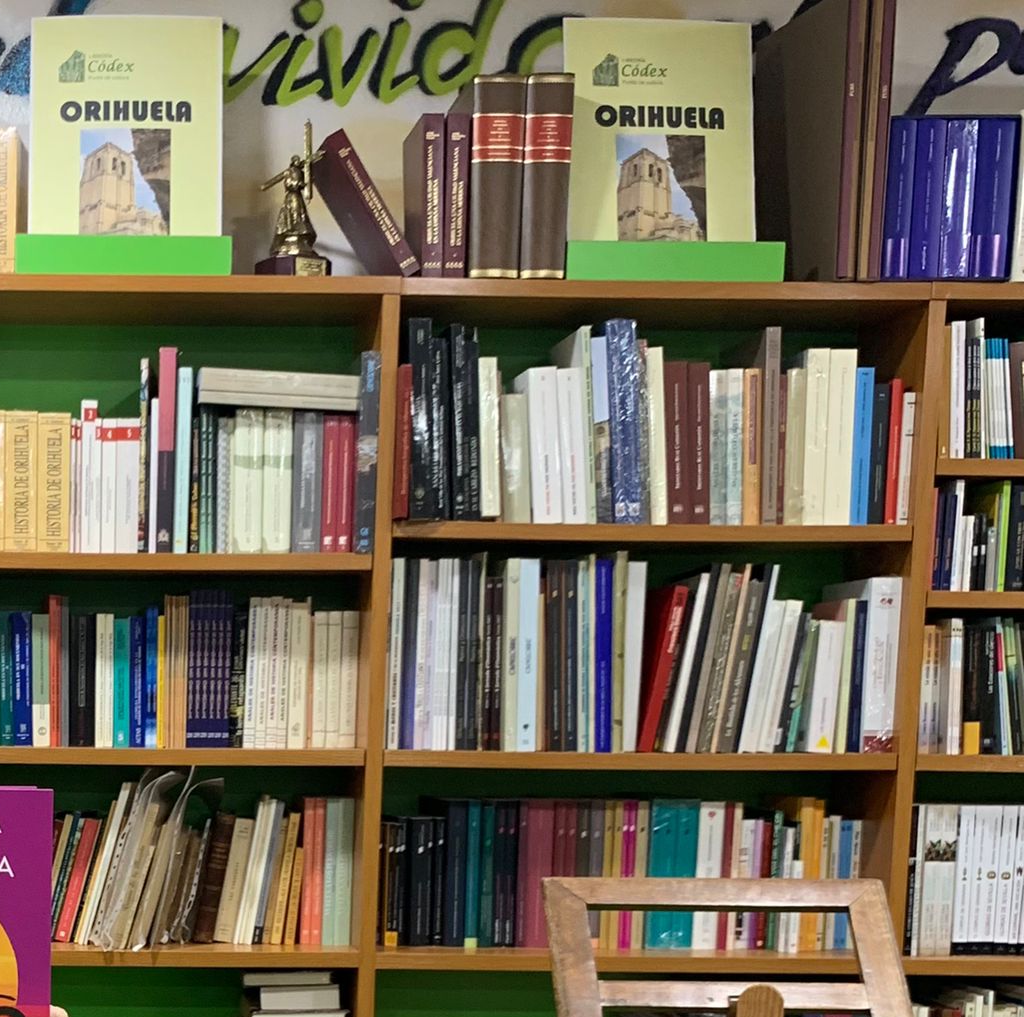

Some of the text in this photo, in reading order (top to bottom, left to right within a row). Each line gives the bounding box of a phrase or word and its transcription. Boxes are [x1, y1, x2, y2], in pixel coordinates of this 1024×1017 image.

[88, 58, 135, 73] Códex
[621, 63, 668, 77] Códex
[60, 100, 192, 122] ORIHUELA
[595, 104, 725, 130] ORIHUELA
[13, 424, 29, 534] HISTORIA DE ORIHUELA
[46, 427, 62, 536] HISTORIA DE ORIHUELA
